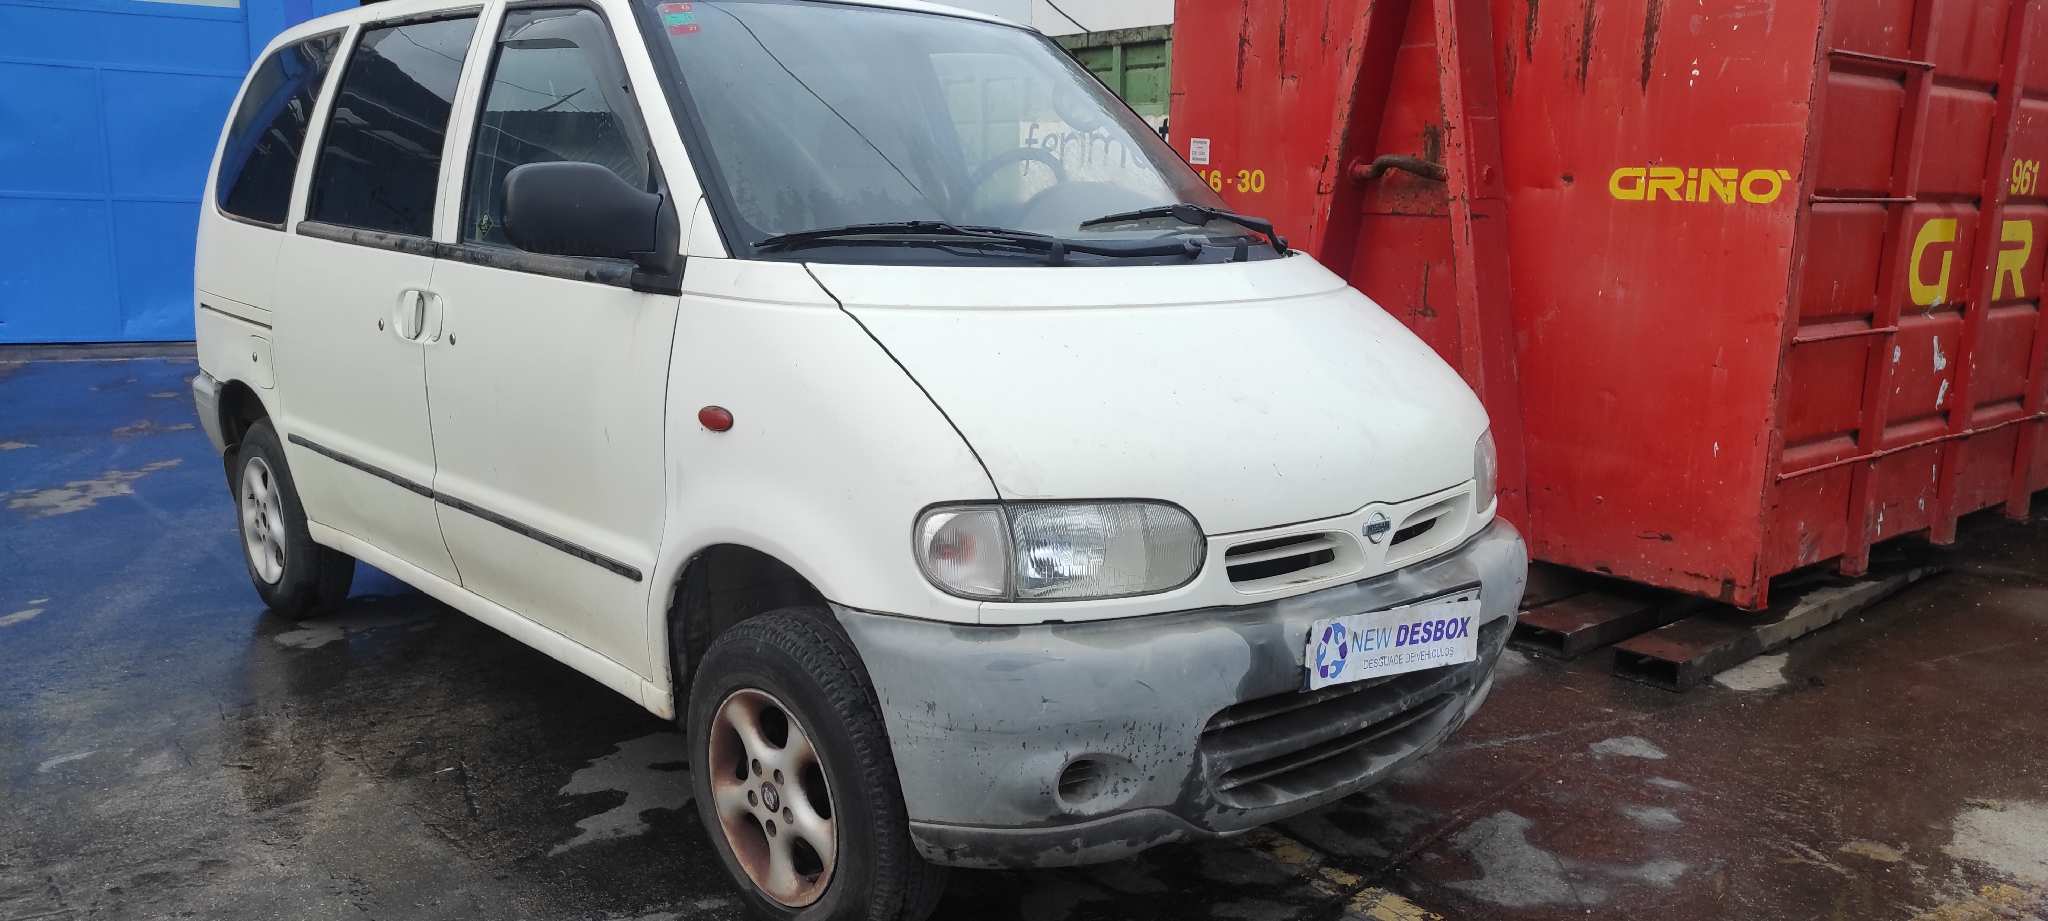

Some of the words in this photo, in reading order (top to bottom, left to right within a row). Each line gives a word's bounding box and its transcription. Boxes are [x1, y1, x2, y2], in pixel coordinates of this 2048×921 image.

[2010, 158, 2040, 196] 961
[1351, 626, 1393, 653] NEW
[1395, 616, 1471, 647] DESBOX
